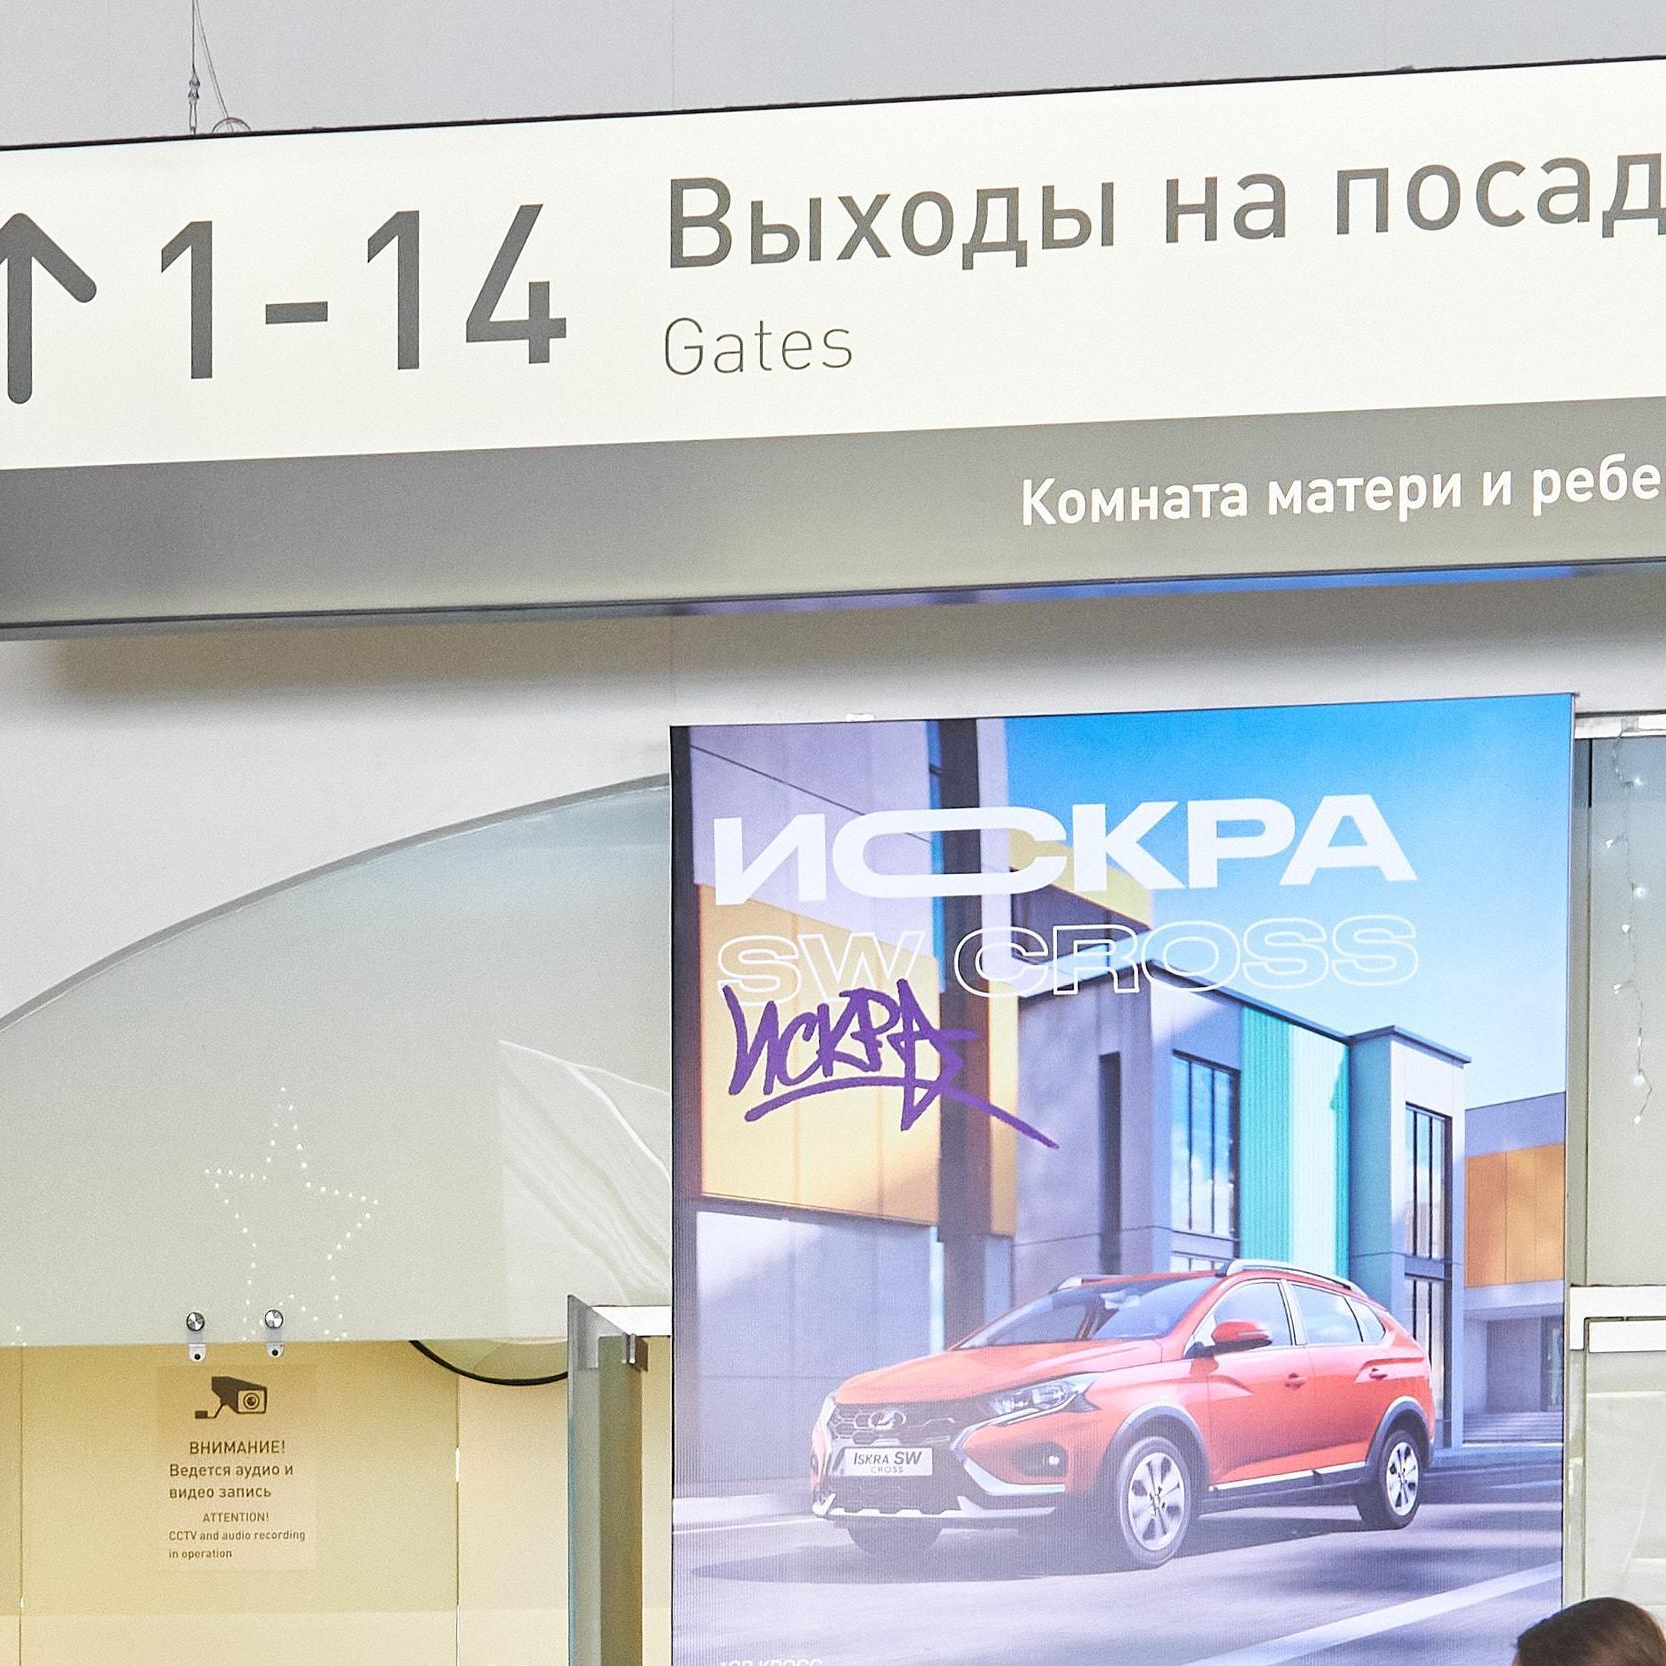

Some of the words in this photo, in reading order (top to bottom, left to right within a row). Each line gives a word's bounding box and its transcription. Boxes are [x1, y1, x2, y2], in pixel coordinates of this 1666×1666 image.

[666, 175, 1115, 271] Выходы
[1166, 170, 1288, 244] на
[159, 202, 568, 381] 1-14
[663, 317, 853, 376] Gates
[1022, 460, 1247, 527] Комната
[1266, 466, 1461, 522] матери
[1480, 464, 1511, 506] и
[712, 793, 1417, 905] ИСКРА
[717, 927, 926, 1006] SW
[953, 915, 1419, 997] CROSS
[189, 1440, 285, 1455] ВНИМАНИЕ!
[894, 1451, 922, 1465] SW
[169, 1464, 231, 1478] Ведется
[236, 1464, 280, 1478] аудио
[284, 1464, 293, 1475] и
[169, 1487, 214, 1499] видео
[219, 1487, 271, 1498] запись
[203, 1513, 269, 1522] ATTENTION!
[169, 1531, 197, 1541] CCTV
[200, 1531, 219, 1541] and
[222, 1530, 251, 1540] audio
[254, 1530, 305, 1542] recording
[169, 1549, 178, 1559] in
[182, 1549, 232, 1560] operation
